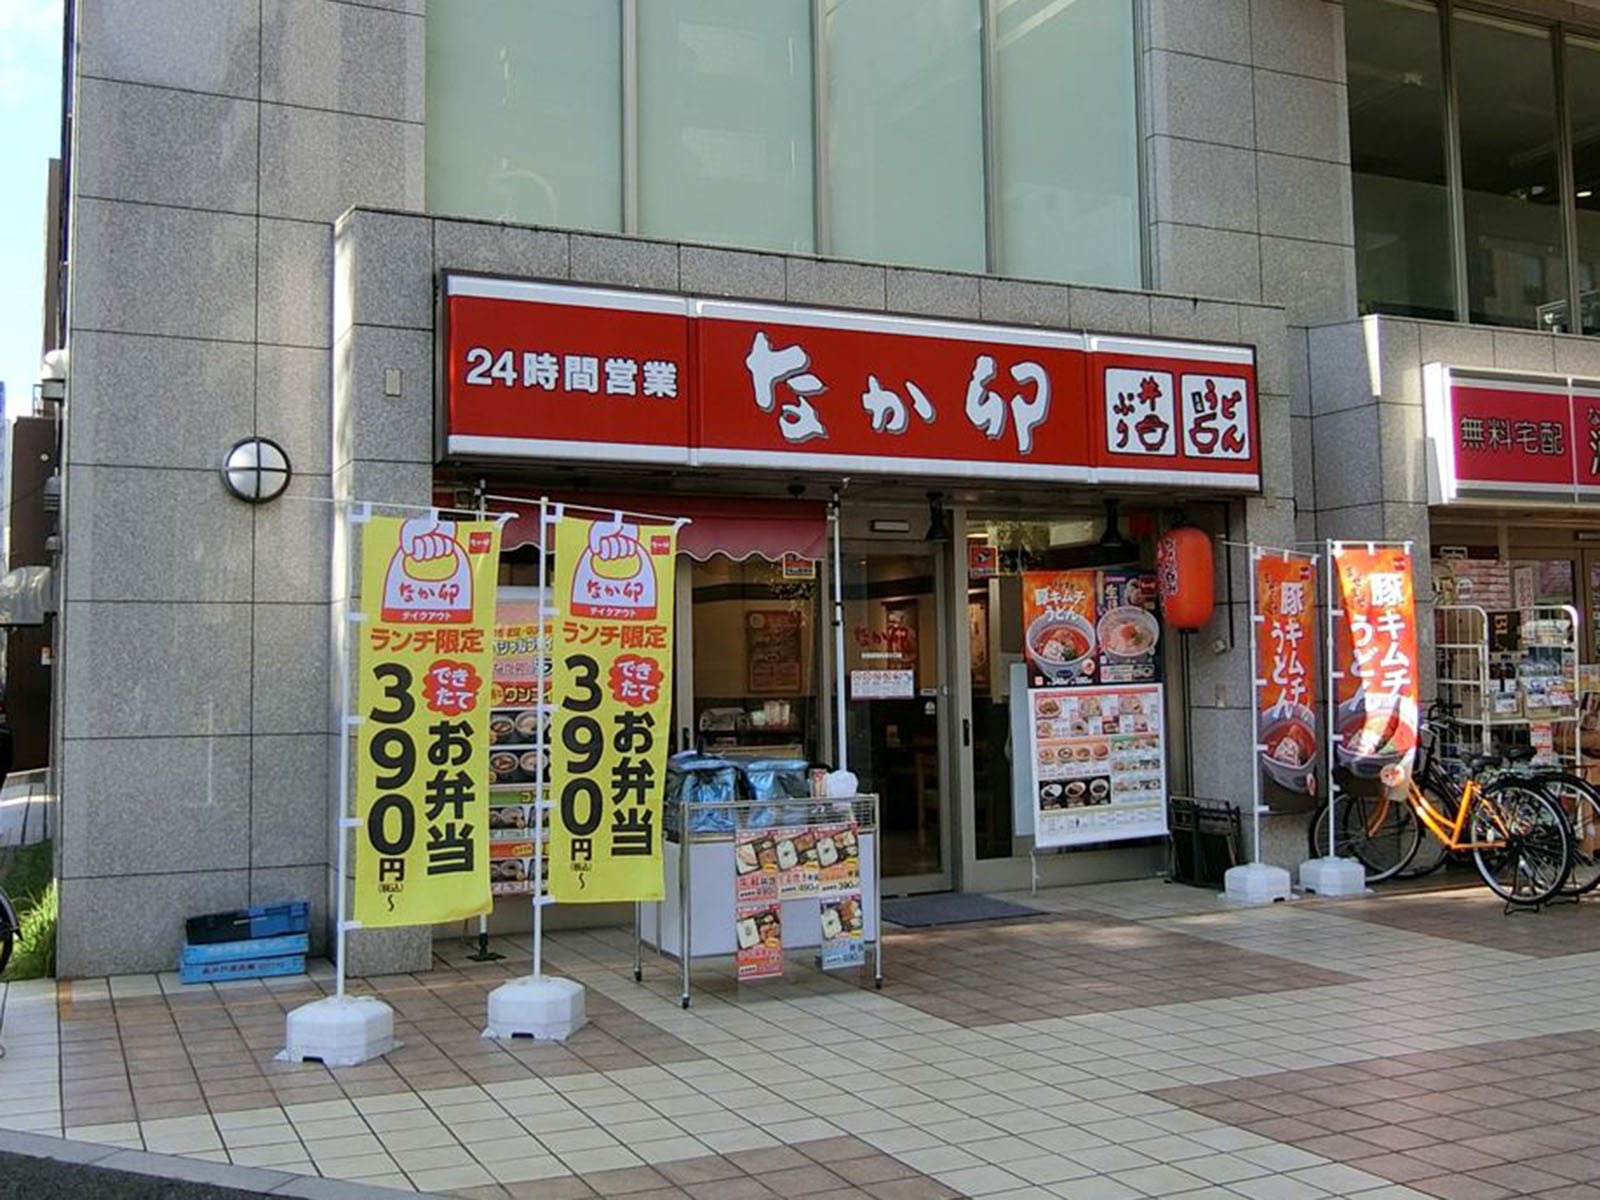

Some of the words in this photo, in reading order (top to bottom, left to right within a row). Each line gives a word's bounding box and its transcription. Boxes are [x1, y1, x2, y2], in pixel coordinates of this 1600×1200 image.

[466, 346, 678, 400] 24時間営業
[745, 331, 1050, 455] なか卯
[1460, 417, 1564, 455] 無料宅配
[398, 583, 460, 605] なか卯
[586, 582, 643, 602] なか卯
[371, 627, 485, 654] ランチ限定
[562, 621, 668, 649] ランチ限定
[425, 720, 476, 876] お弁当
[611, 711, 655, 857] お弁当
